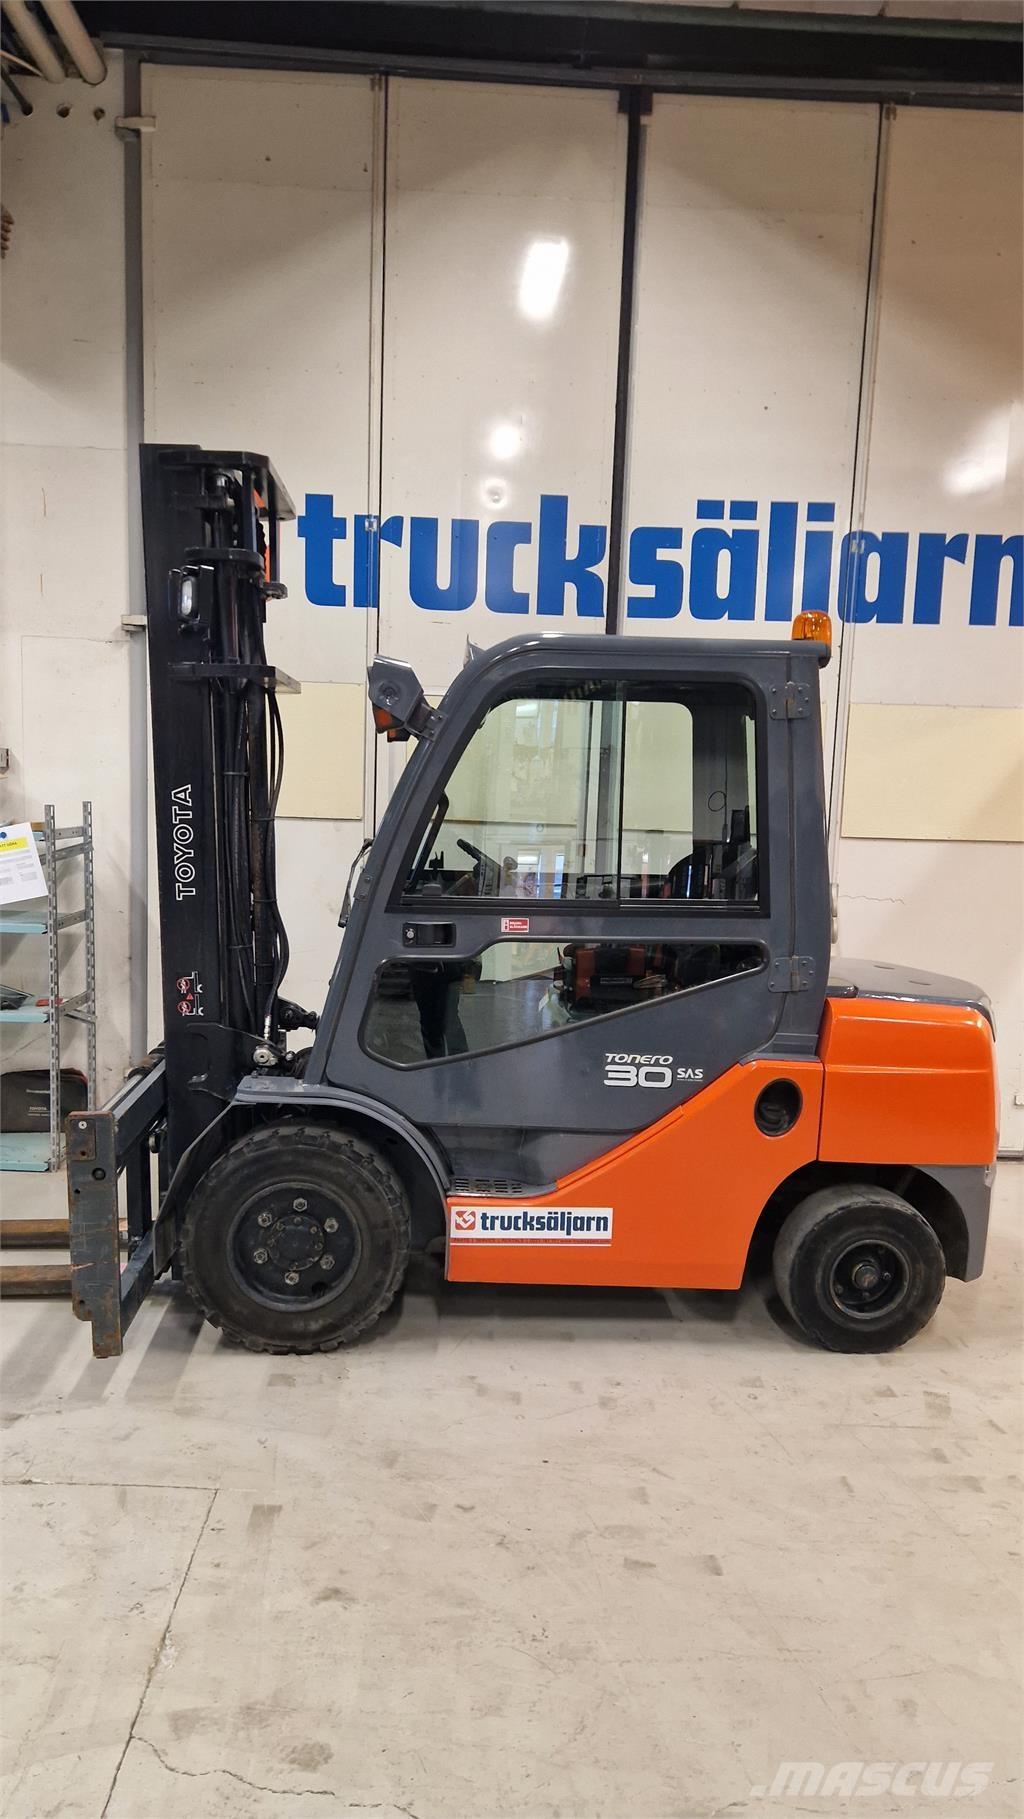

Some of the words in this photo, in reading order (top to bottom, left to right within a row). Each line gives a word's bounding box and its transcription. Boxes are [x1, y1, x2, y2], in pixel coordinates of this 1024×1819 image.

[172, 784, 196, 901] TOYOTA
[605, 1053, 674, 1065] TONERO
[603, 1064, 673, 1088] 30
[677, 1068, 704, 1079] SAS
[480, 1211, 609, 1236] trucksäljarn
